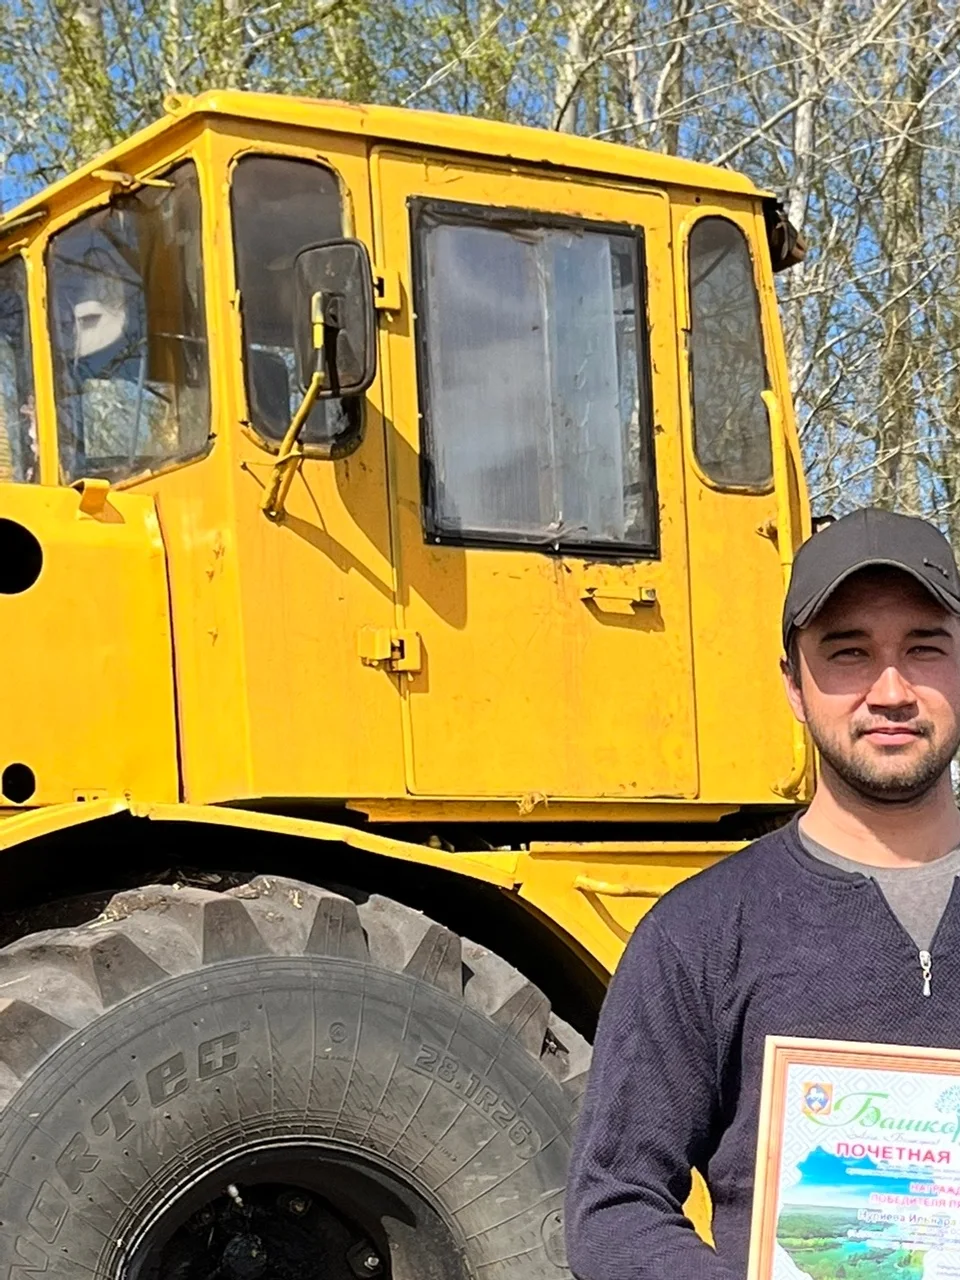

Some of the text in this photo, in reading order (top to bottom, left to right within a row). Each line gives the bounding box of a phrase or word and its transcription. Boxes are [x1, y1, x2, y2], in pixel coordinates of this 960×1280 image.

[415, 1044, 533, 1147] 28.1R26
[836, 1142, 951, 1165] ПОЧЕТНАЯ
[871, 1194, 946, 1208] ПОБЕДИТЕЛЯ
